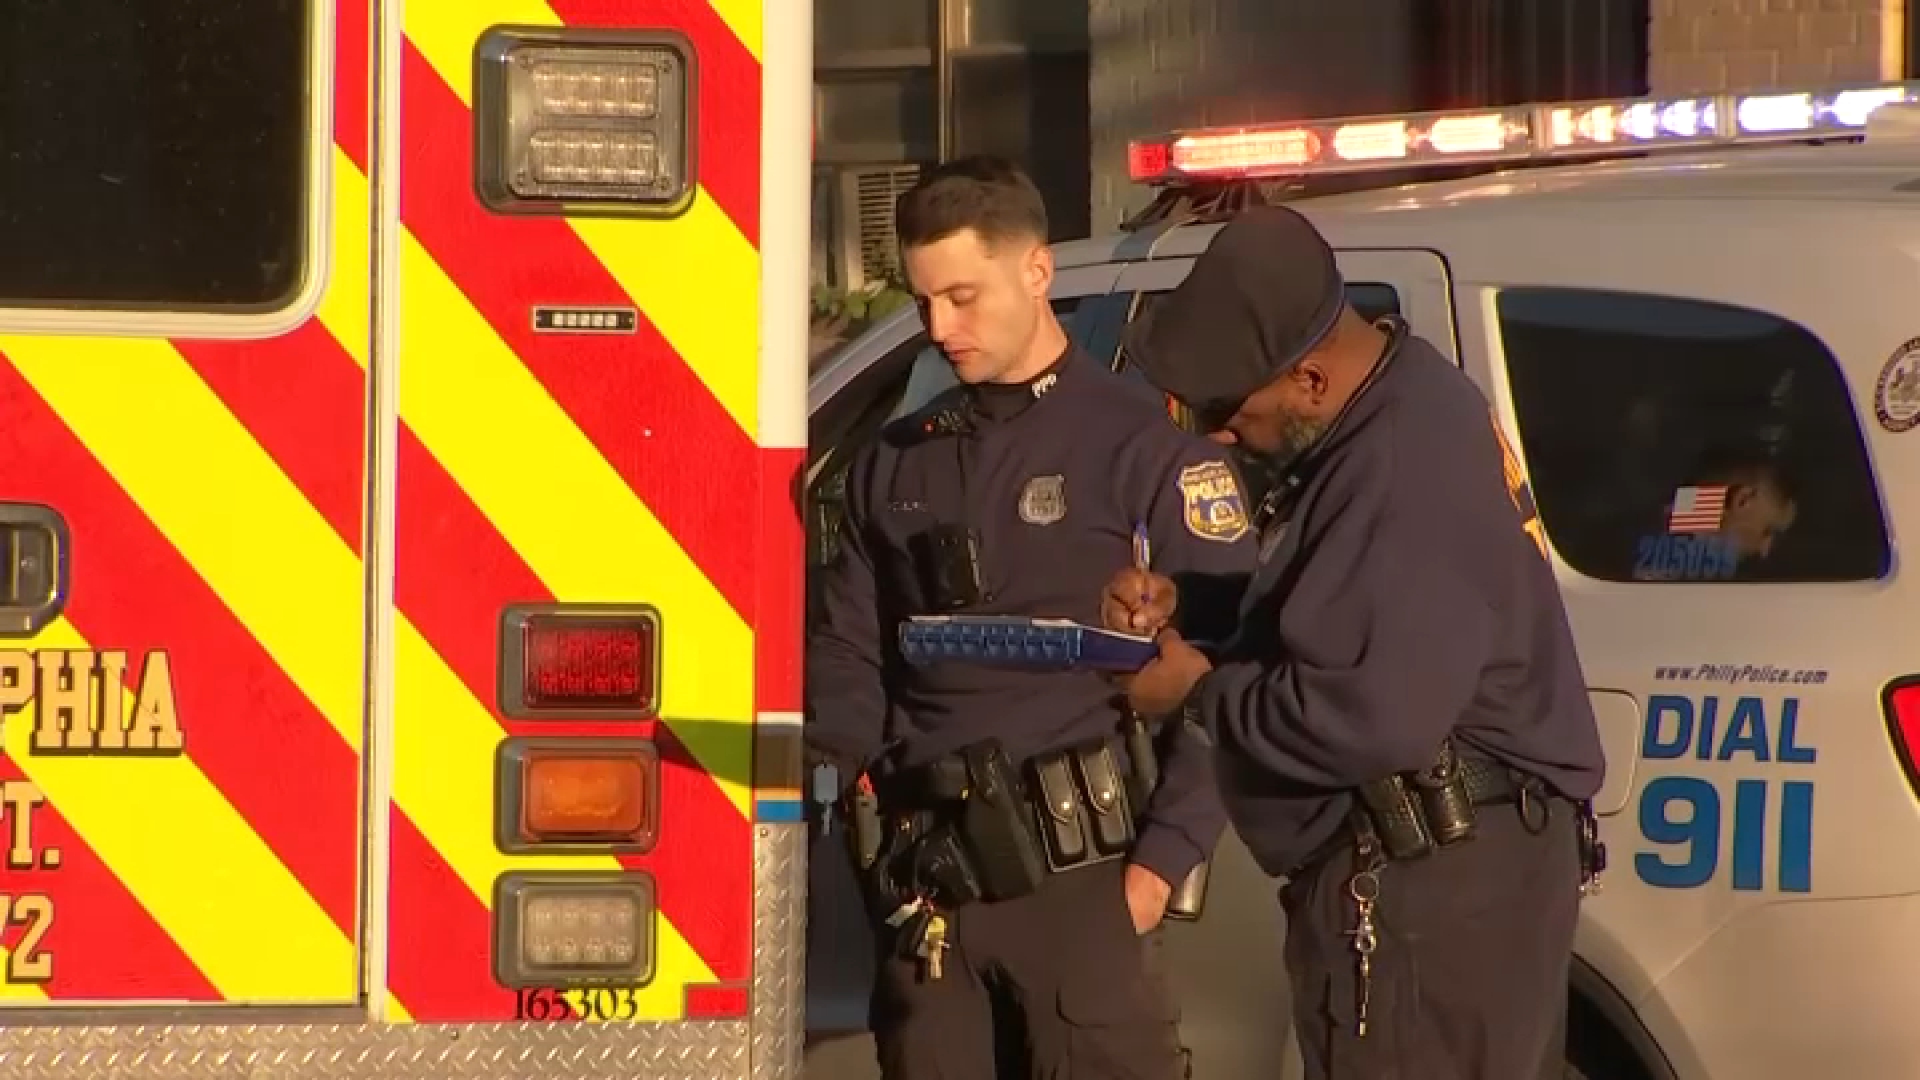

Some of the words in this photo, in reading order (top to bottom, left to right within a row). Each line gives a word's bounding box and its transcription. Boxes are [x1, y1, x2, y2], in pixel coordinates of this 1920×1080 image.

[0, 647, 184, 756] PHIA
[1654, 663, 1829, 684] www.PhillyPolice.com
[1642, 694, 1817, 763] DIAL
[0, 779, 61, 871] T.
[1634, 776, 1815, 892] 911
[513, 986, 638, 1020] 165303
